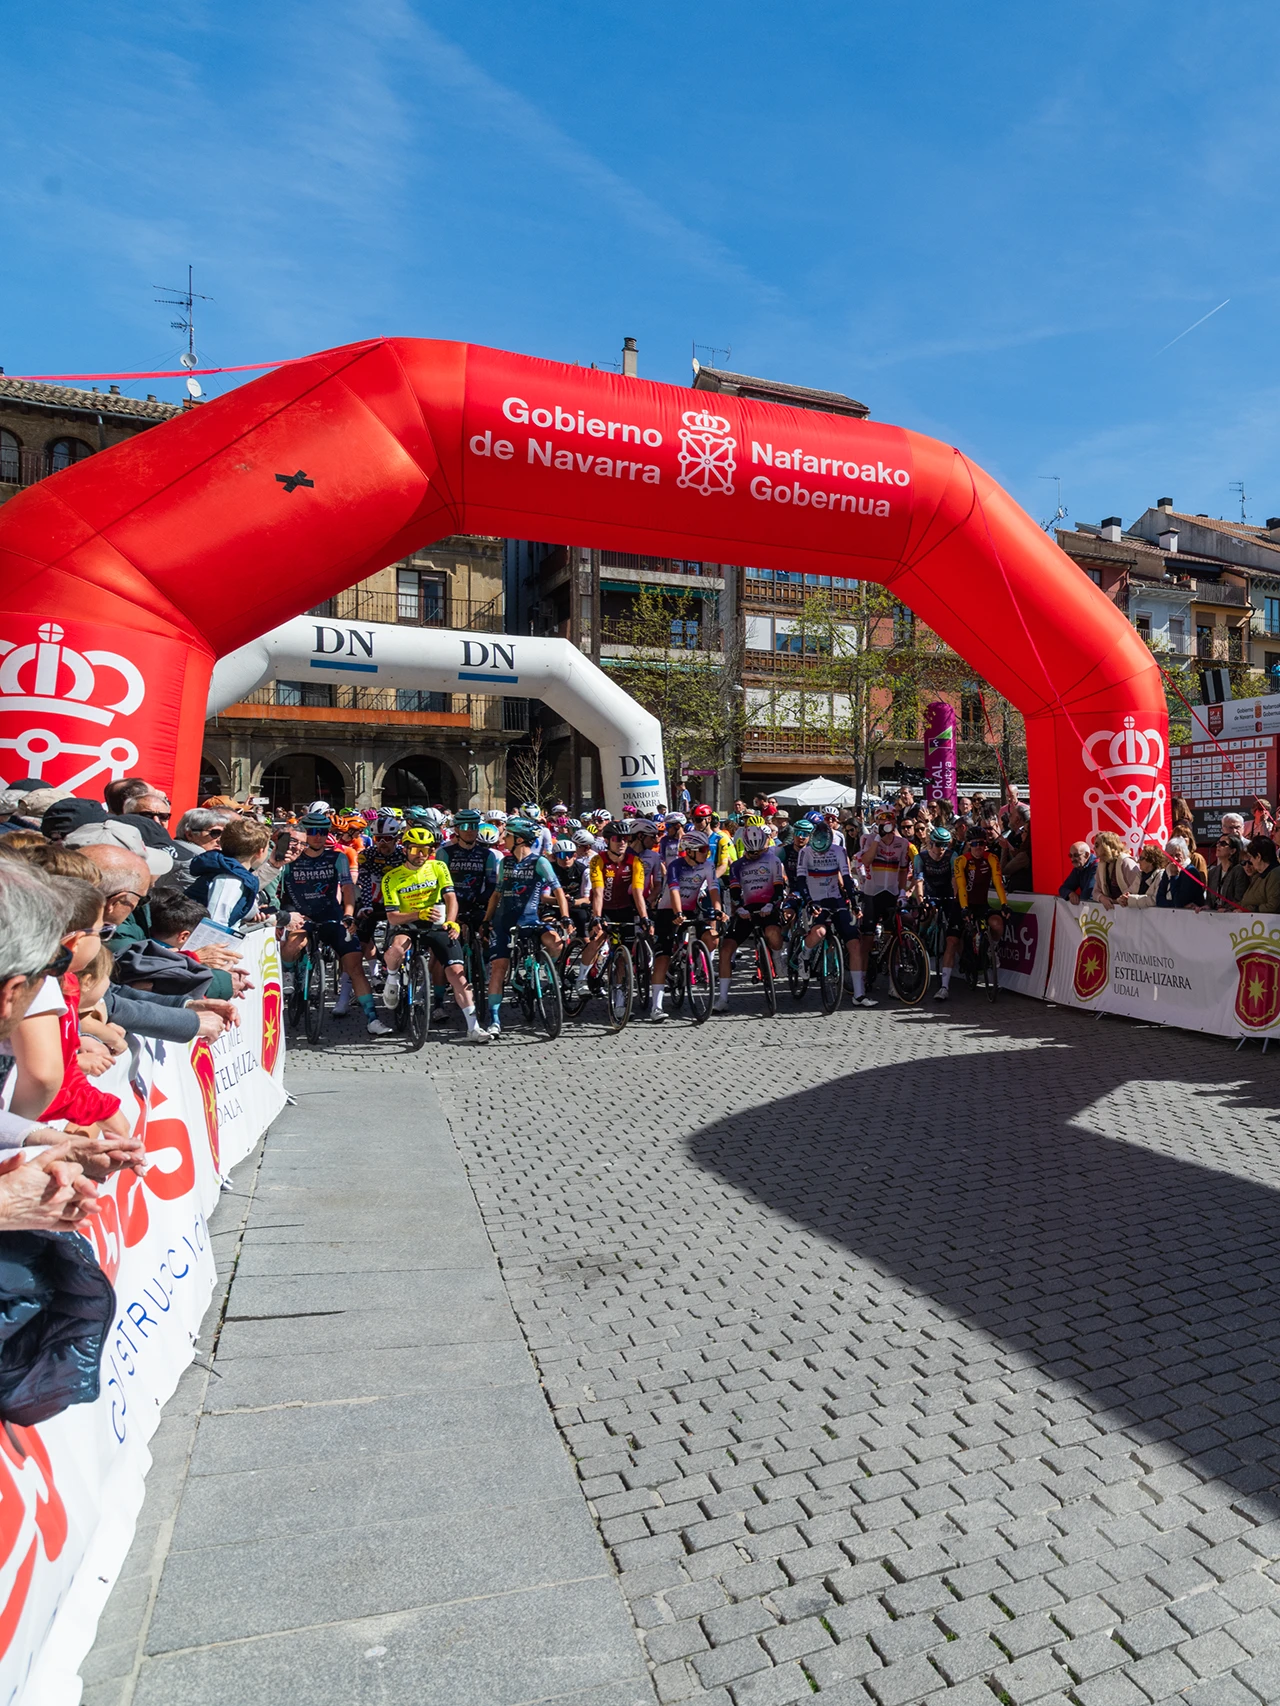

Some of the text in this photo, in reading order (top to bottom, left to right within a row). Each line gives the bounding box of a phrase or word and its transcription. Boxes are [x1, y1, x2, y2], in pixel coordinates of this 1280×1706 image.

[502, 397, 662, 448] Gobierno
[469, 430, 661, 485] de Navarra
[751, 441, 910, 487] Nafarroako
[749, 476, 891, 518] Gobernua
[312, 625, 375, 658] DN
[460, 640, 516, 670] DN
[619, 754, 656, 777] DN
[944, 761, 952, 789] kutxa
[623, 792, 649, 800] DIARIO
[293, 868, 334, 877] BAHRAIN
[399, 879, 438, 894] anicolor
[1114, 951, 1174, 969] AYUNTAMIENTO
[1114, 967, 1192, 990] ESTELLA-LIZARRA
[1114, 984, 1140, 998] UDALA
